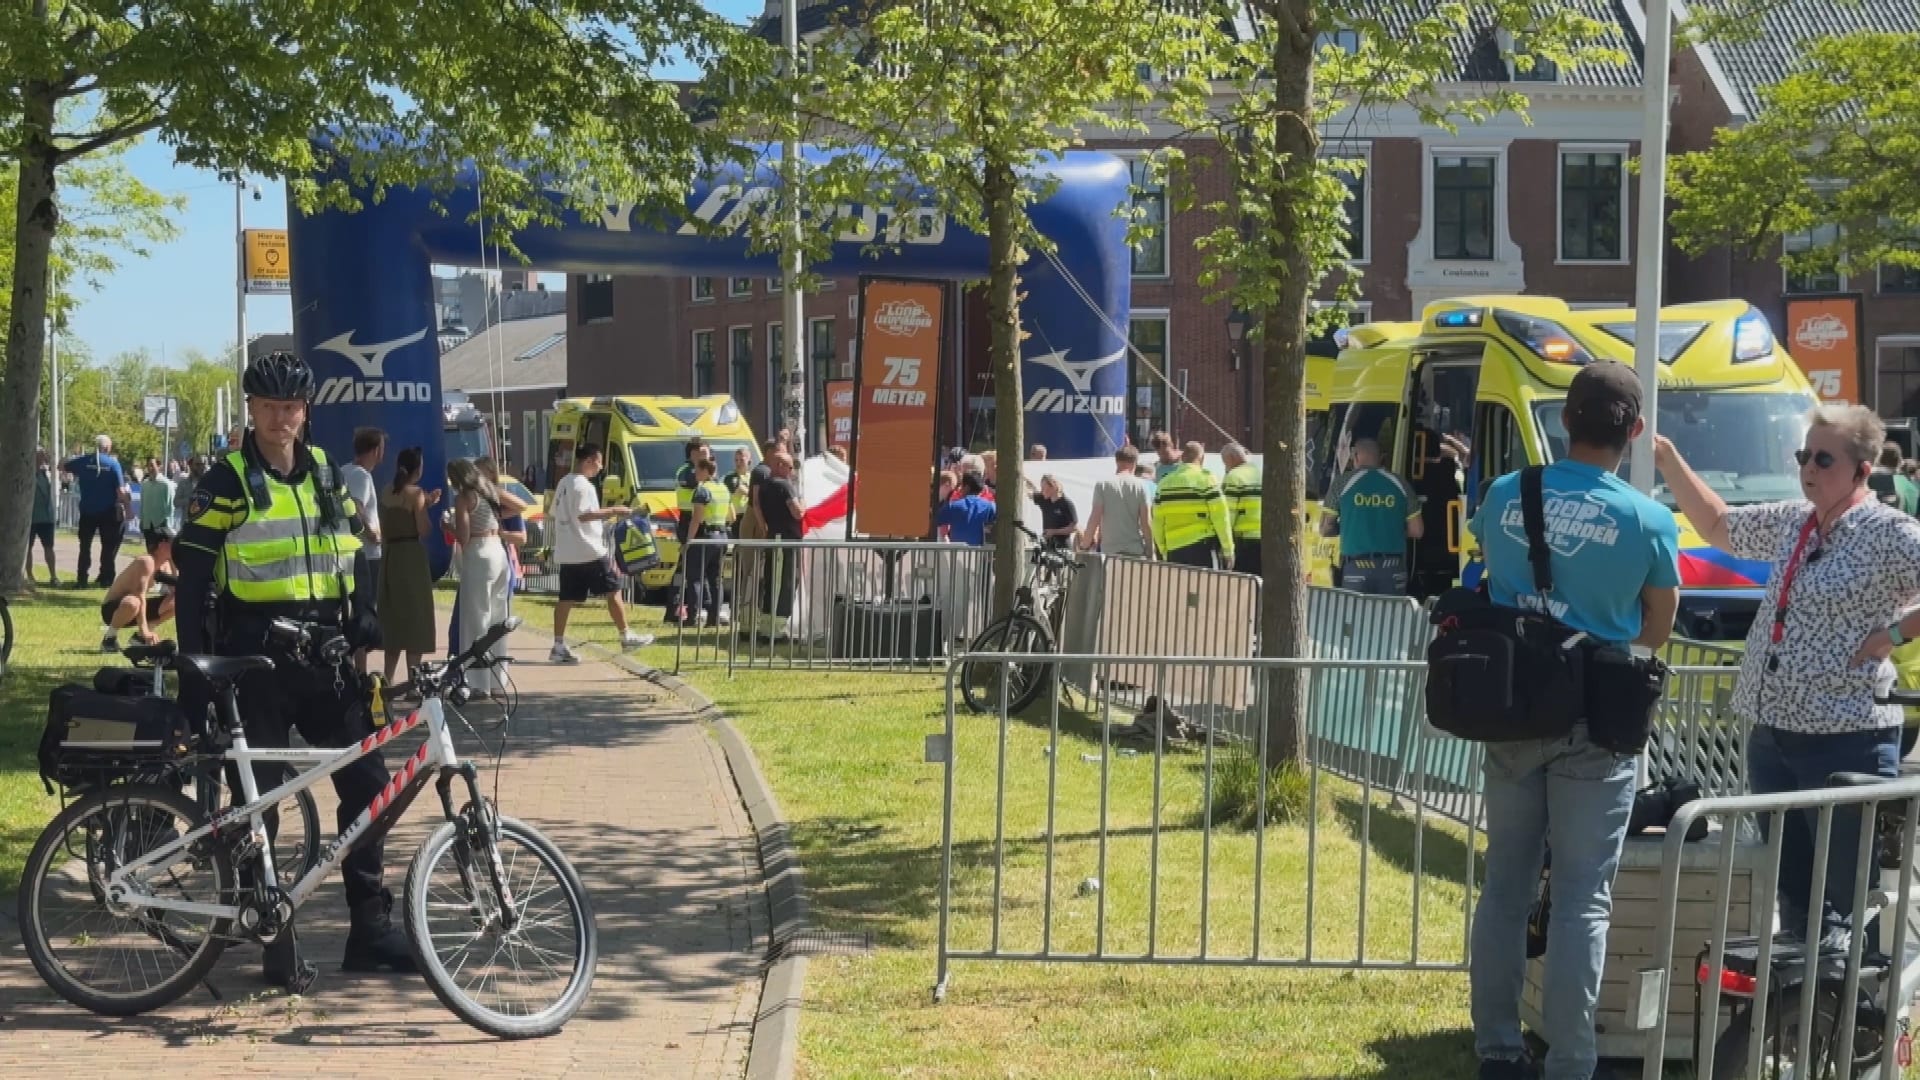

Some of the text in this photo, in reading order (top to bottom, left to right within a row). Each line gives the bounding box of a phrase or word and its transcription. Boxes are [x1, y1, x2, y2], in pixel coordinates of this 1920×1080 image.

[881, 356, 922, 387] 75
[1807, 368, 1842, 397] 75
[313, 376, 431, 405] MIZUNO
[871, 388, 927, 407] METER
[1024, 388, 1123, 415] MIZUNO
[1354, 493, 1395, 508] OvD-G
[1543, 498, 1601, 521] OOP
